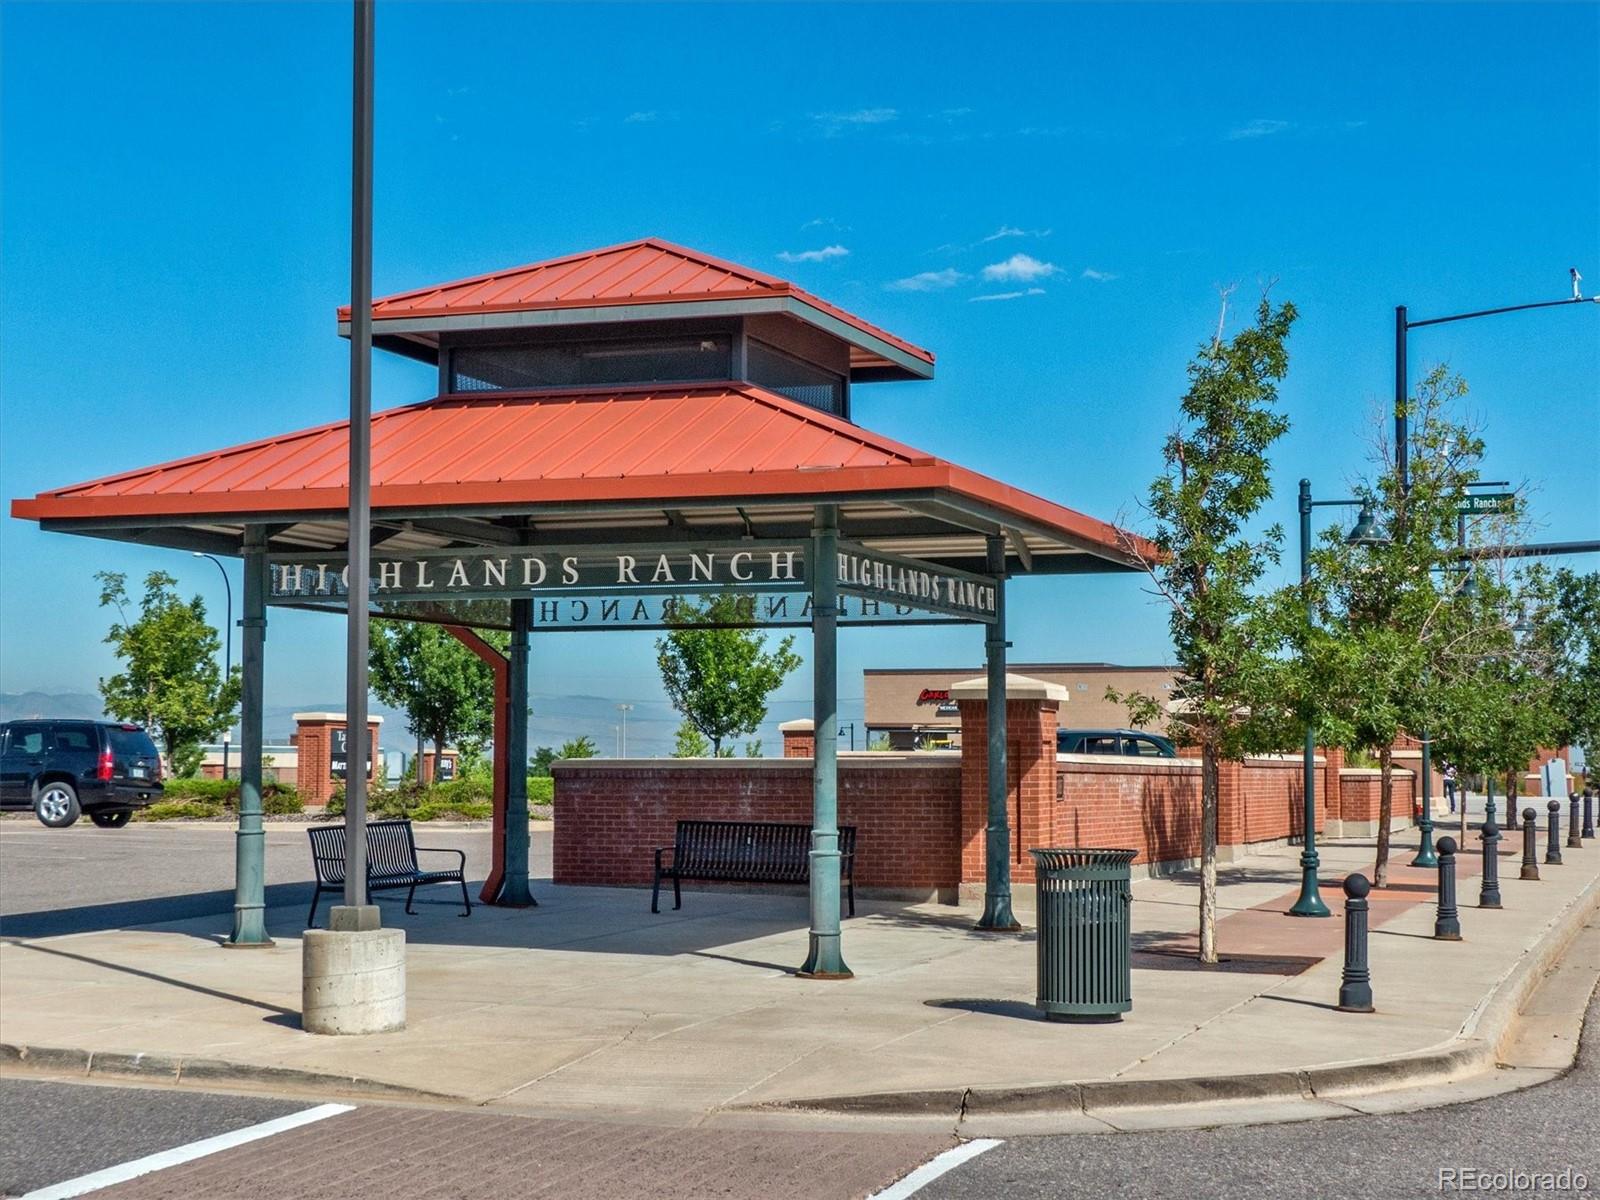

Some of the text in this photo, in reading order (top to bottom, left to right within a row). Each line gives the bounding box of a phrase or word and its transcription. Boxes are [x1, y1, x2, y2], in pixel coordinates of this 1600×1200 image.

[1473, 497, 1497, 509] Ranch
[280, 551, 796, 591] HIHLANDS RANCH
[837, 552, 996, 612] HIGHLANDS RANCH
